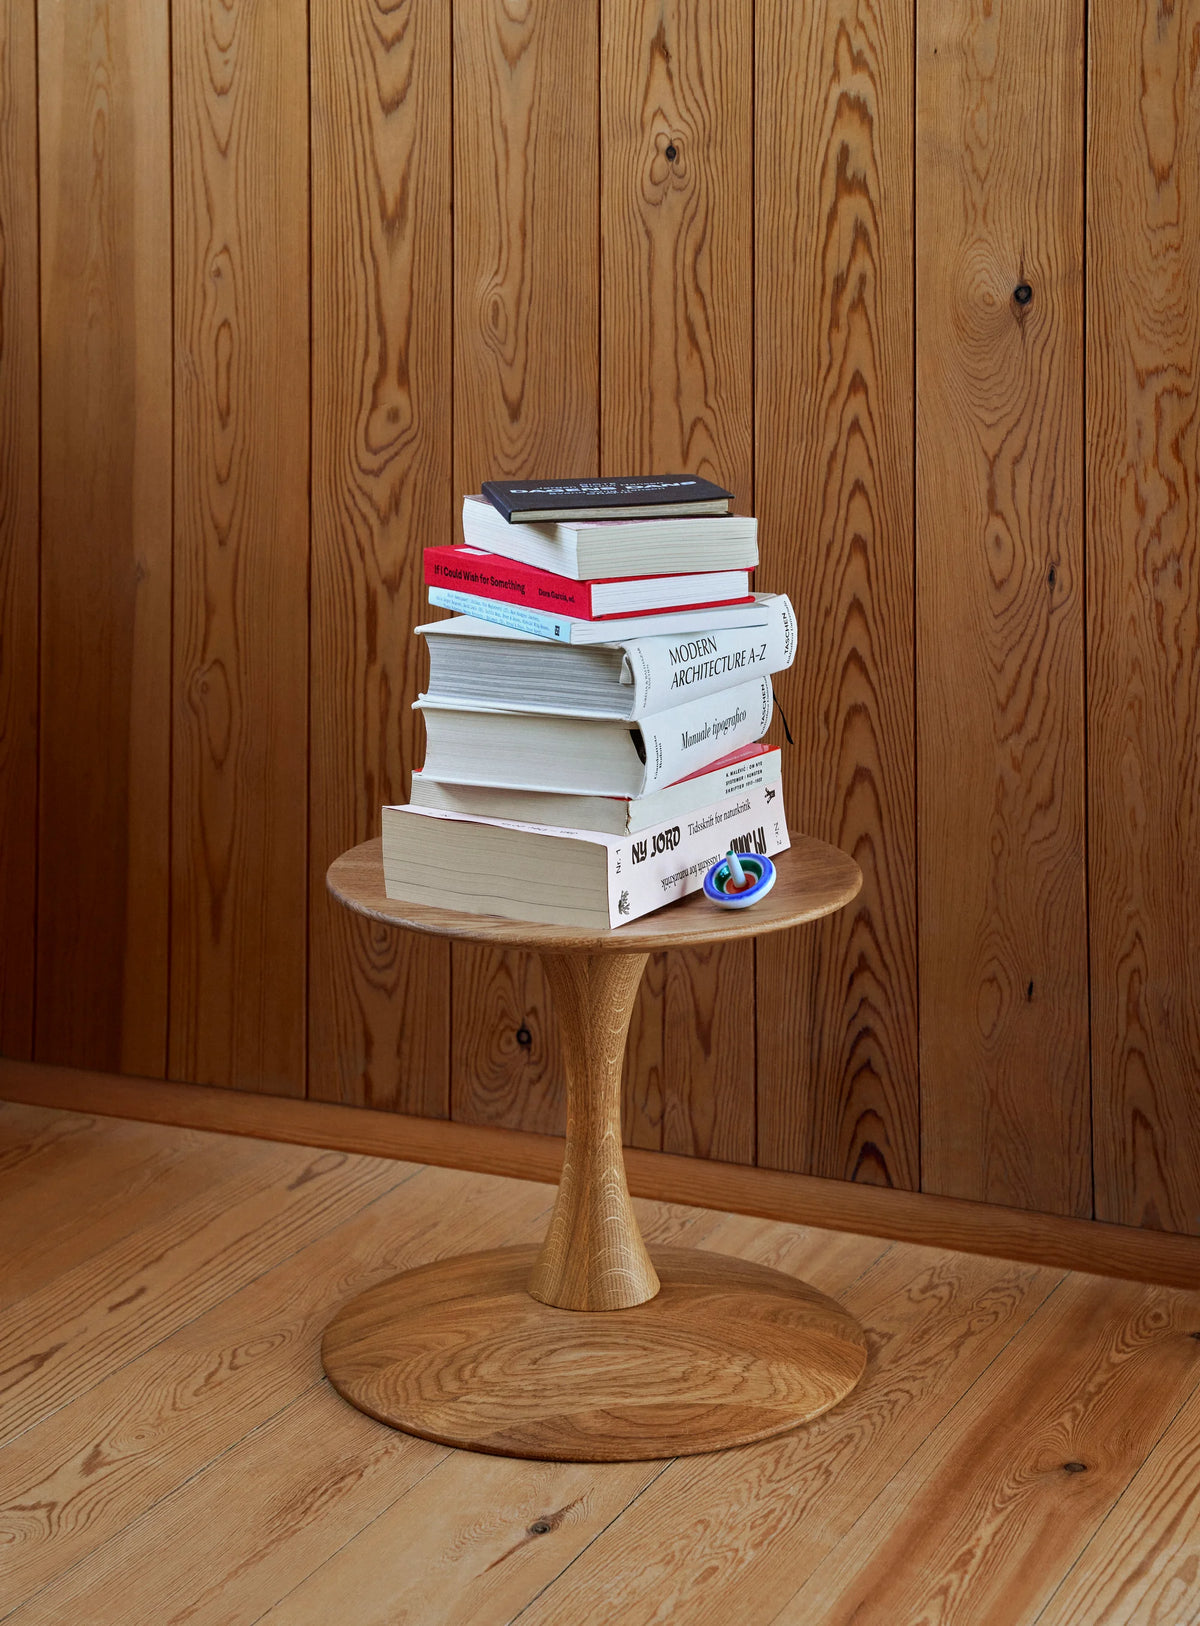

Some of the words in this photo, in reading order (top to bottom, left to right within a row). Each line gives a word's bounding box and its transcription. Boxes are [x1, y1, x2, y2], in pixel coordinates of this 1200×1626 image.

[434, 564, 441, 574] If
[443, 566, 462, 580] Could
[463, 570, 479, 582] Wish
[480, 573, 489, 585] for
[490, 576, 525, 595] Something
[538, 588, 550, 597] Dora
[668, 635, 718, 666] MODERN
[781, 612, 789, 655] TASCHEN
[670, 649, 747, 690] ARCHITECTURE
[681, 722, 711, 751] Manuale
[712, 707, 747, 740] tipografico
[687, 815, 714, 836] Tidsskrift
[714, 811, 722, 824] for
[723, 798, 751, 820] naturkritik
[631, 838, 648, 865] NY
[650, 825, 681, 858] JORD
[660, 868, 689, 891] naturkritik
[689, 865, 698, 877] for
